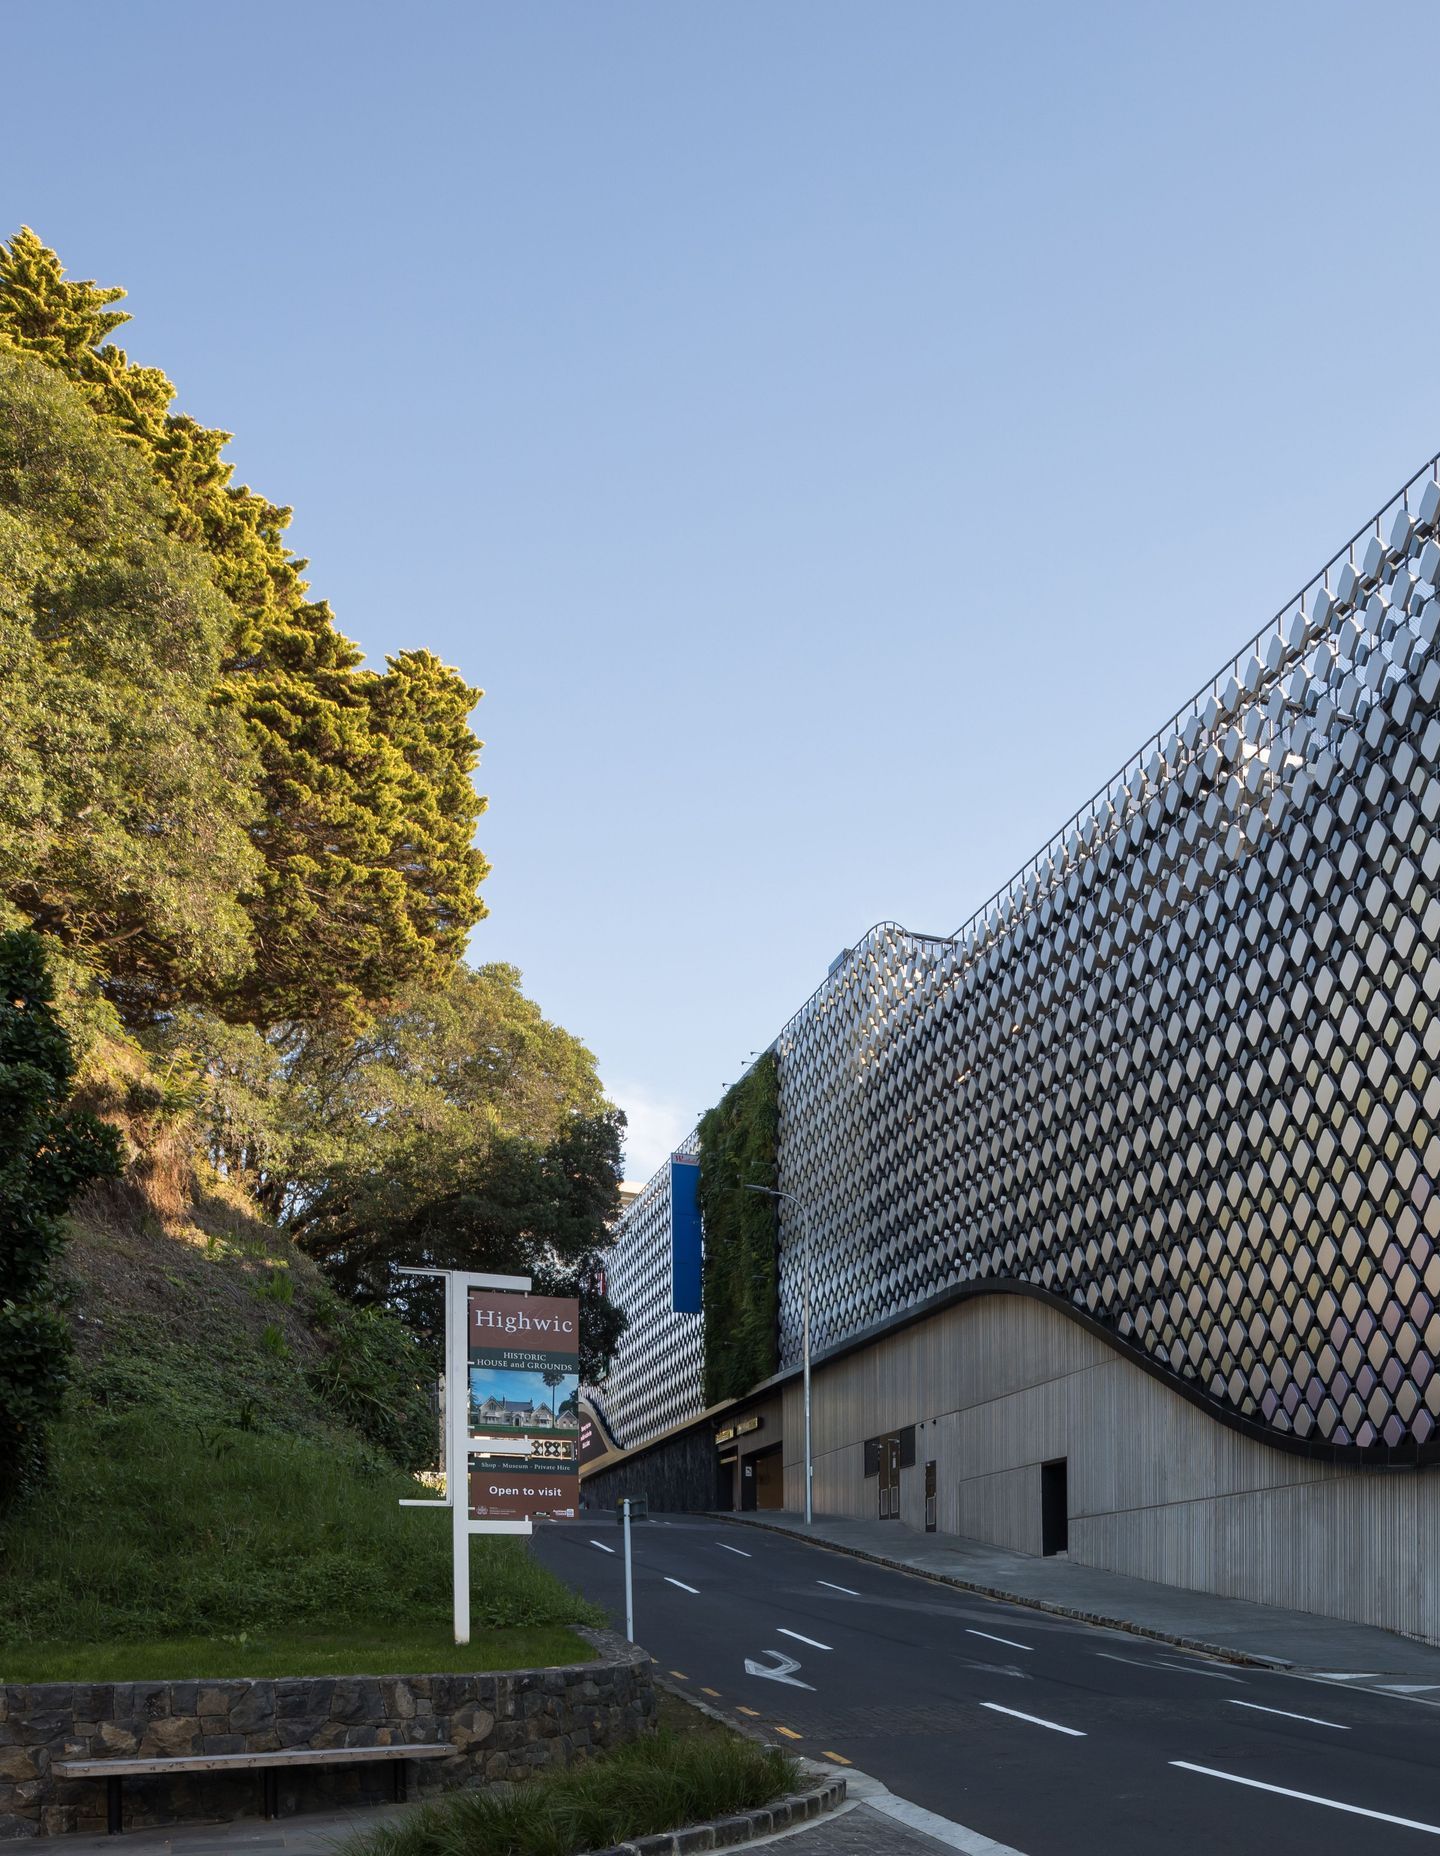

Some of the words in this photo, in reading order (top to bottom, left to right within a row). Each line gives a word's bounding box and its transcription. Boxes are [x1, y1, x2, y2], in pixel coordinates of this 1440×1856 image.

[475, 1310, 573, 1333] Highwic
[503, 1352, 546, 1361] HISTORIC
[477, 1359, 508, 1367] HOUSE
[527, 1362, 572, 1371] GROUNDS
[489, 1486, 519, 1496] Open
[522, 1487, 535, 1496] to
[538, 1487, 562, 1497] visit
